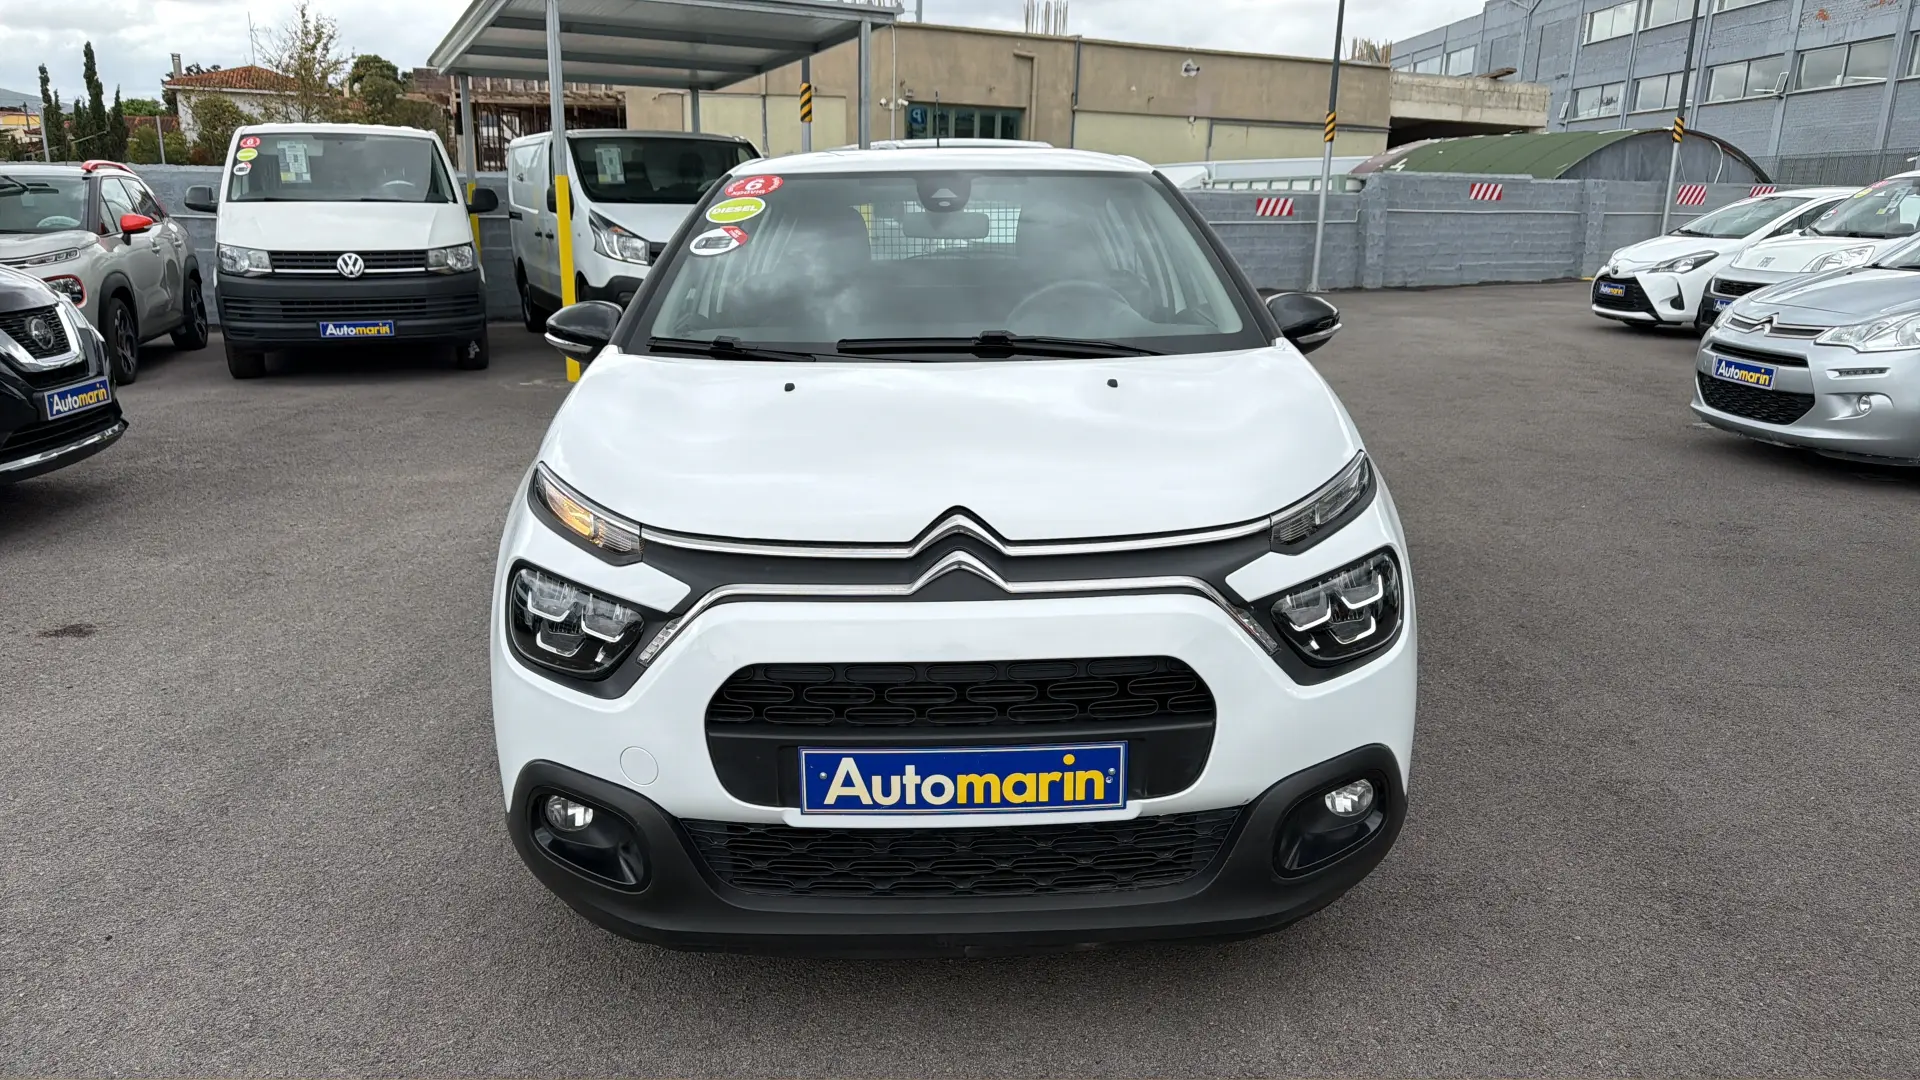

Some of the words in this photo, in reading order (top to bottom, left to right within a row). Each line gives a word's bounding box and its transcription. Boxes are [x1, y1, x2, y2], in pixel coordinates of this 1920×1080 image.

[745, 178, 765, 190] 6
[711, 205, 758, 214] DIESEL
[326, 322, 390, 336] Automarin
[1717, 361, 1770, 385] Automarin
[52, 382, 107, 415] Automarin
[823, 753, 1105, 806] Automarin
